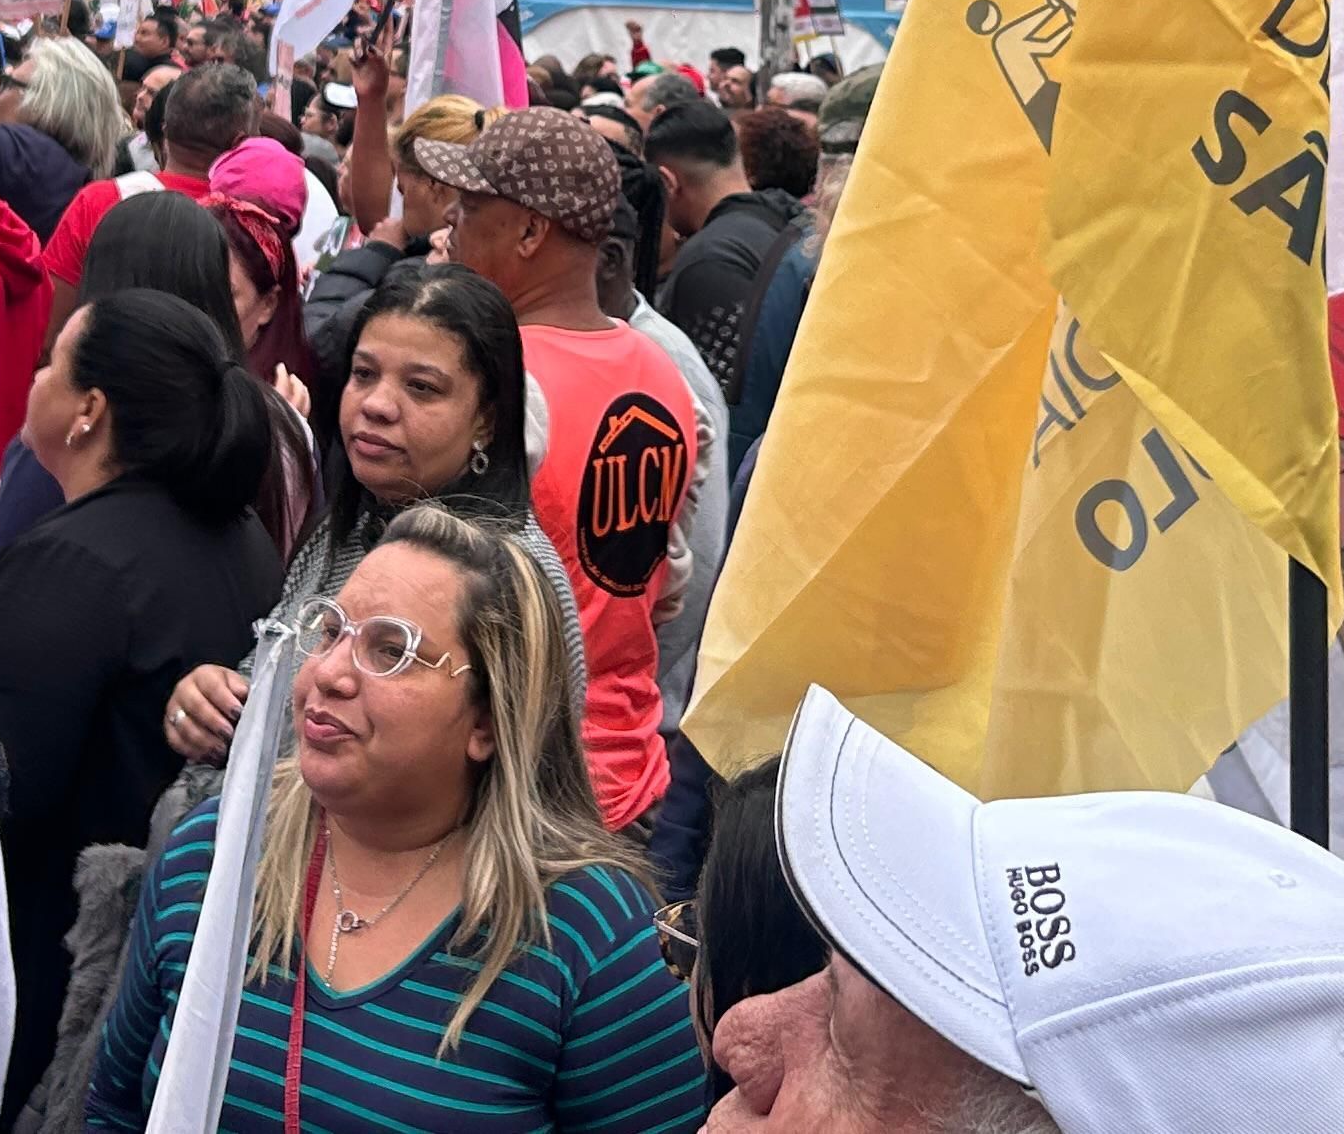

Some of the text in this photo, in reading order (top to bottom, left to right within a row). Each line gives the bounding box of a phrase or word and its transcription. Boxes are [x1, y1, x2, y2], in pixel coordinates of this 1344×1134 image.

[1005, 866, 1040, 977] HUGO BOSS
[1025, 861, 1076, 970] BOSS
